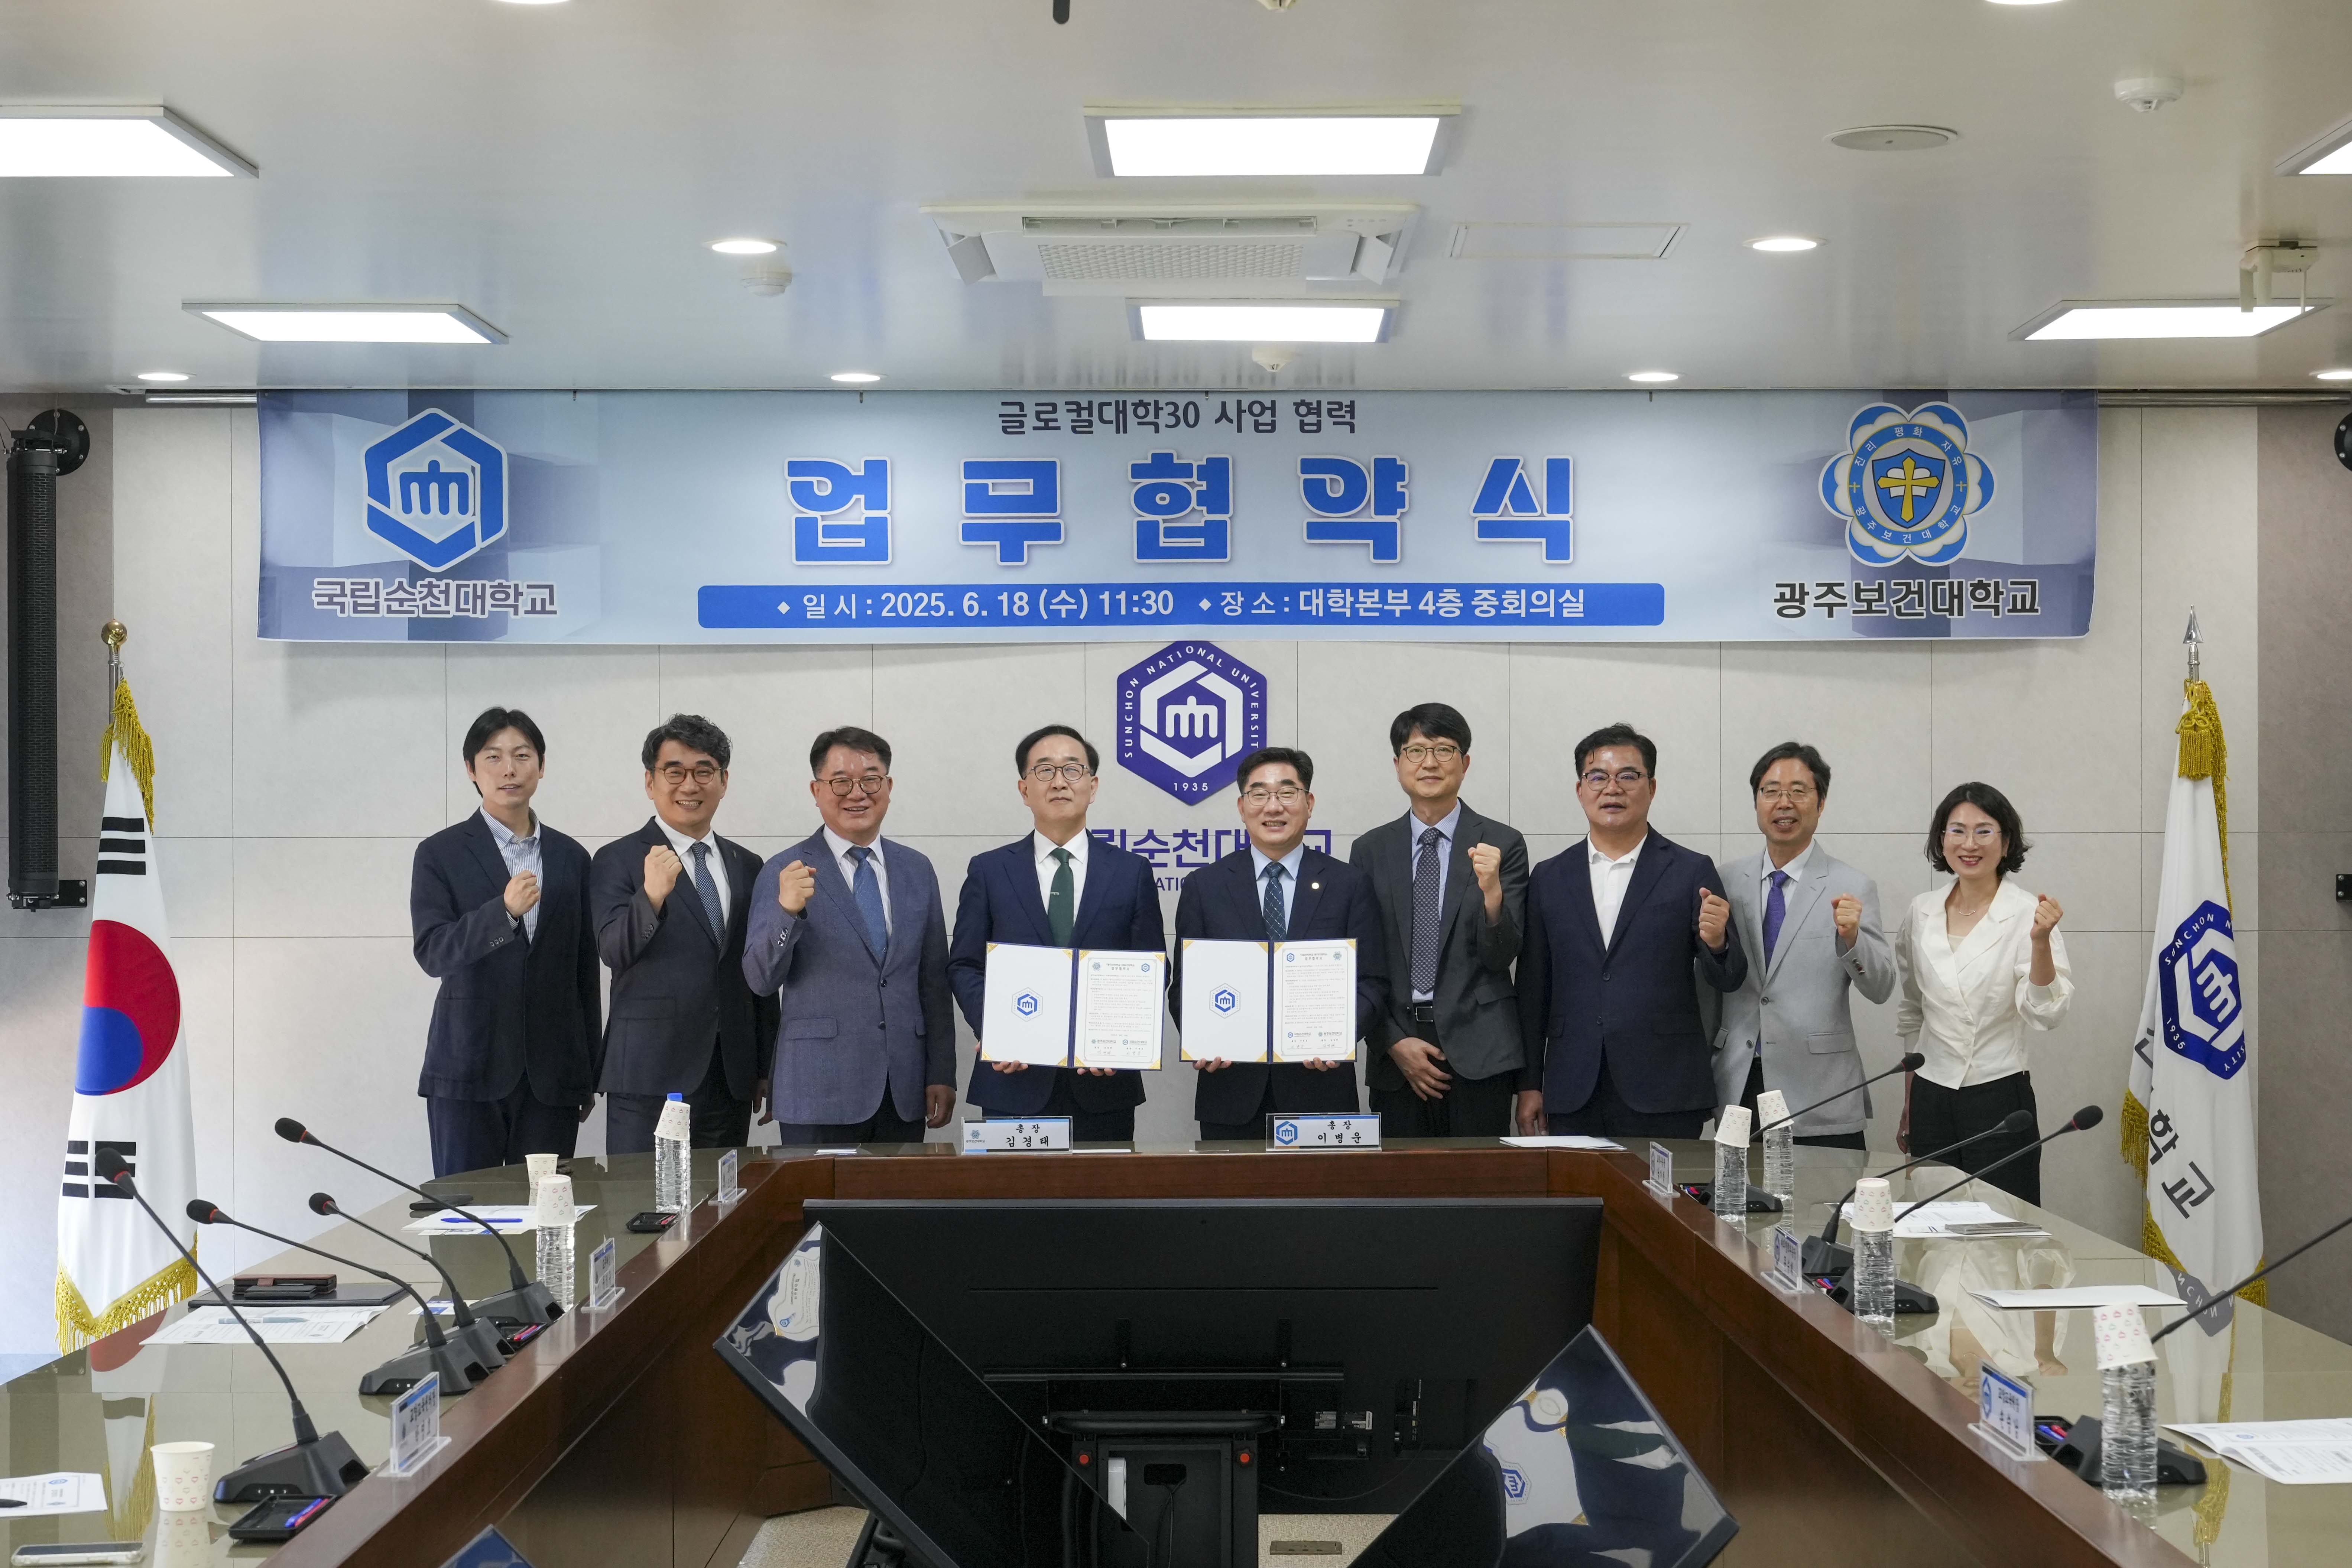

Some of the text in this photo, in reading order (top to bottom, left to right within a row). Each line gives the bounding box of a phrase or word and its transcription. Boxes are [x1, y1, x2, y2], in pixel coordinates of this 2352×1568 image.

[998, 399, 1356, 435] 글로컬대학30 사업 협력
[1854, 426, 1962, 467] 진리 평화 자유
[1855, 504, 1961, 544] 광주보건대학교
[314, 580, 557, 617] 국립순천대학교
[997, 591, 1029, 616] 18
[1099, 590, 1174, 615] 11:30
[1300, 588, 1412, 617] 대학본부
[1418, 588, 1463, 618] 4층
[1471, 589, 1584, 618] 중회의실
[1774, 580, 2040, 619] 광주보건대학교
[1125, 646, 1259, 758] SUNCHON NATIONAL UNIVERSIT
[1174, 782, 1209, 791] 1935
[2165, 913, 2214, 965] SUNCHON
[2166, 1017, 2186, 1049] 1935
